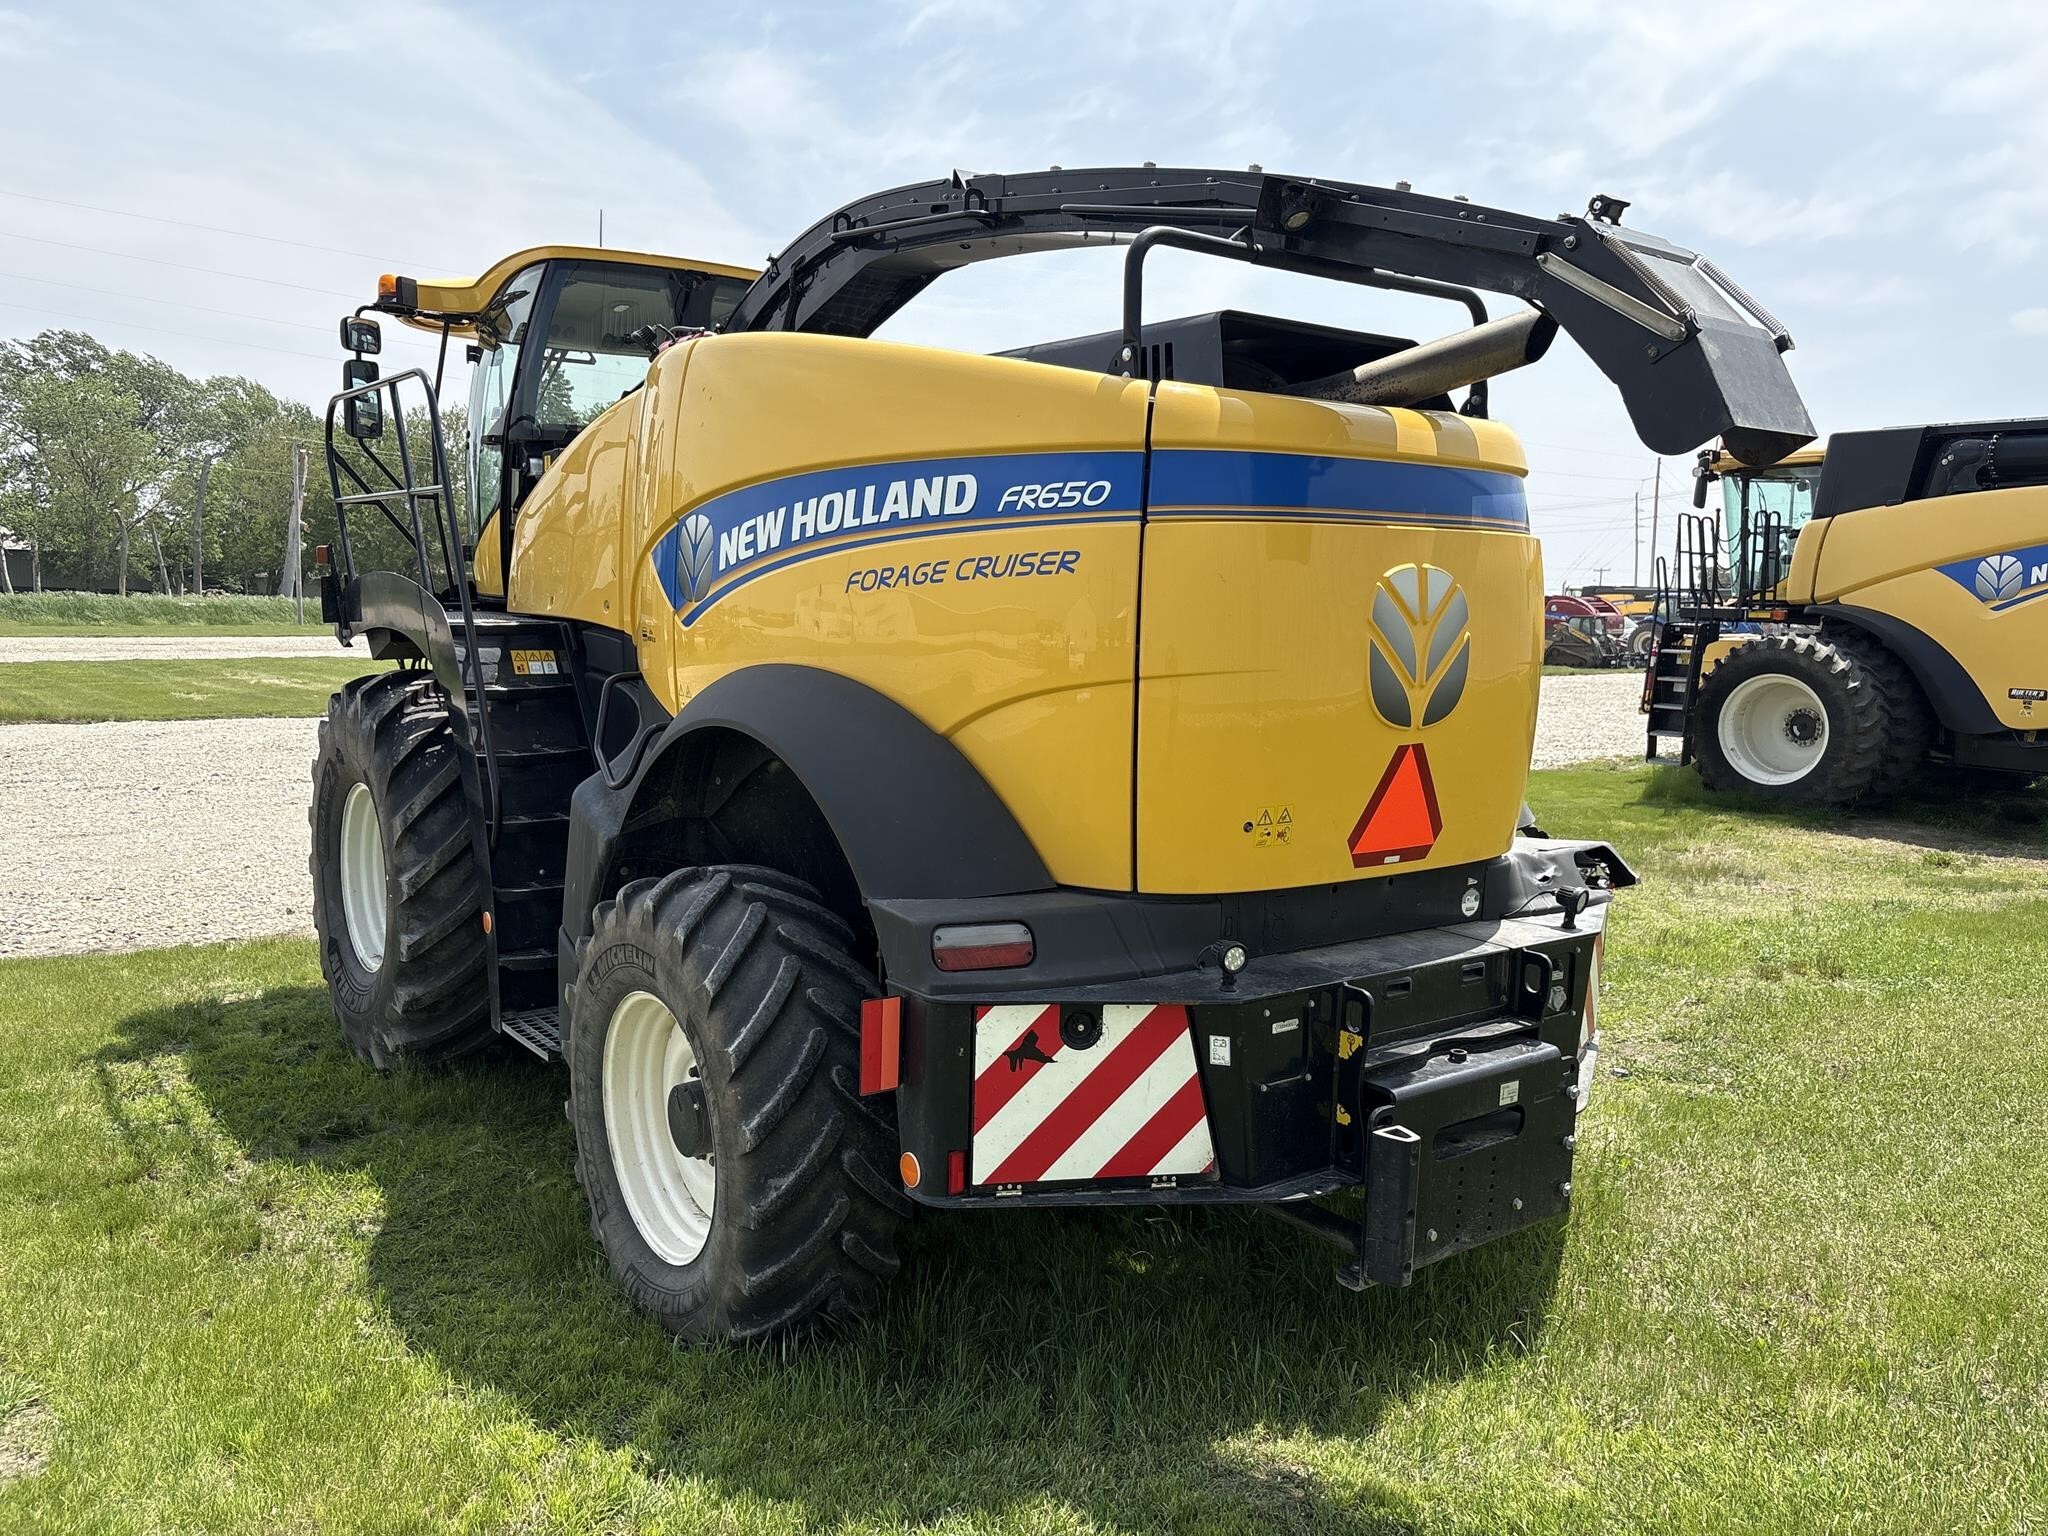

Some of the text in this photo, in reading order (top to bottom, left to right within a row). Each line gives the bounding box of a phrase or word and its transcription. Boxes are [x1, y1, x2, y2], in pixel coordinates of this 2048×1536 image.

[997, 480, 1112, 513] FR650
[718, 474, 978, 571] NEW HOLLAND
[845, 550, 1081, 594] FORAGE CRUISER
[595, 944, 655, 978] MICHELIN
